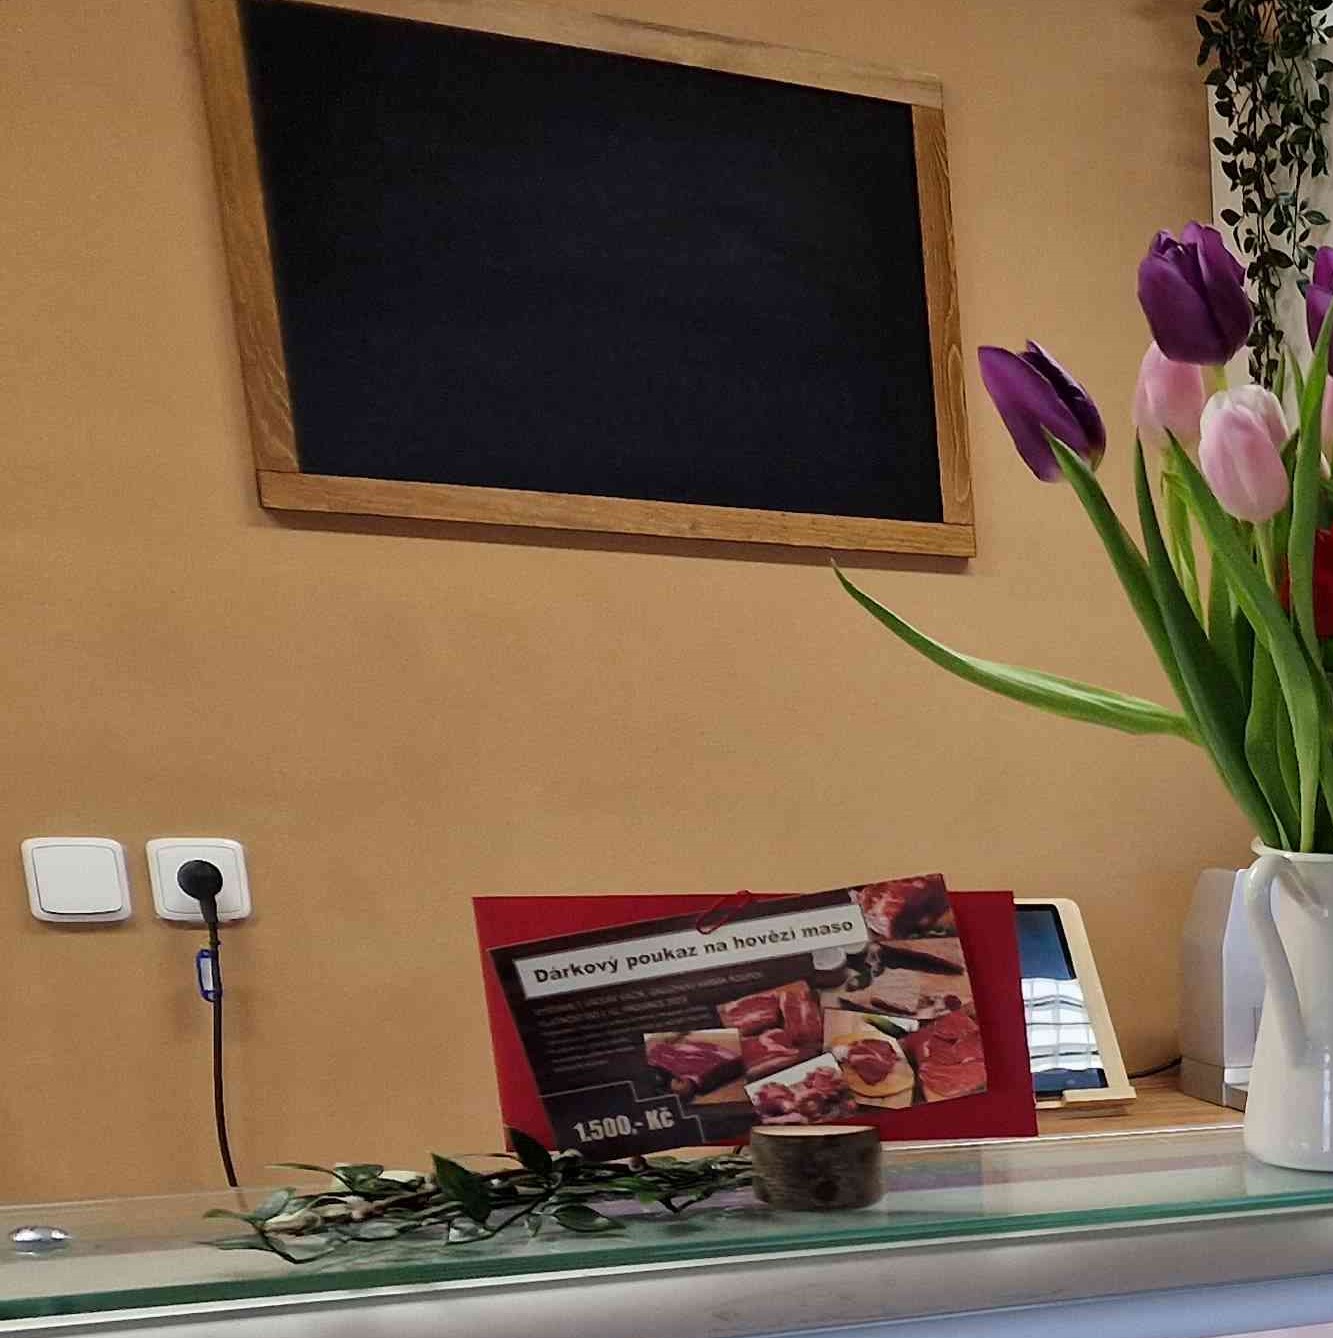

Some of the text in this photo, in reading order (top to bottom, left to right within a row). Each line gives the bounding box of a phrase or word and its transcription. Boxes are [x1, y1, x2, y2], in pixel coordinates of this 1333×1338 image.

[534, 919, 854, 983] Dárkový poukaz na hovězí maso
[645, 1107, 675, 1131] Kč
